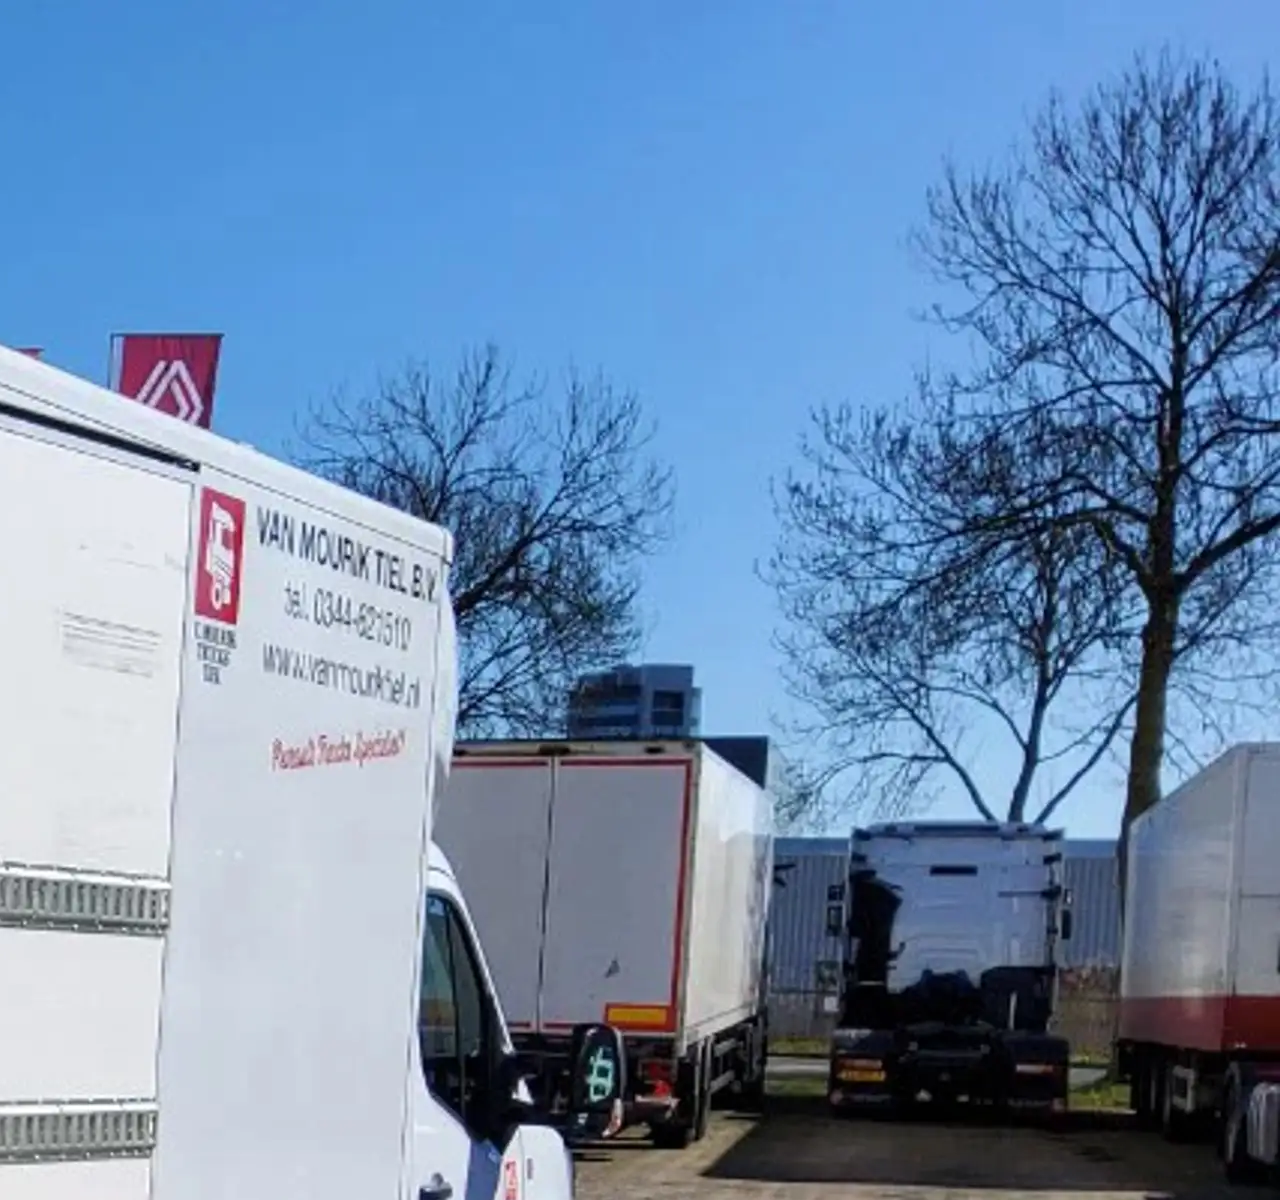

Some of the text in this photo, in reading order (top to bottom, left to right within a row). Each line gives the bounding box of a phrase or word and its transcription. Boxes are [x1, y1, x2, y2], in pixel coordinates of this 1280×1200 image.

[257, 505, 295, 557] VAN
[299, 521, 372, 581] MOURIK
[375, 548, 408, 595] TIEL
